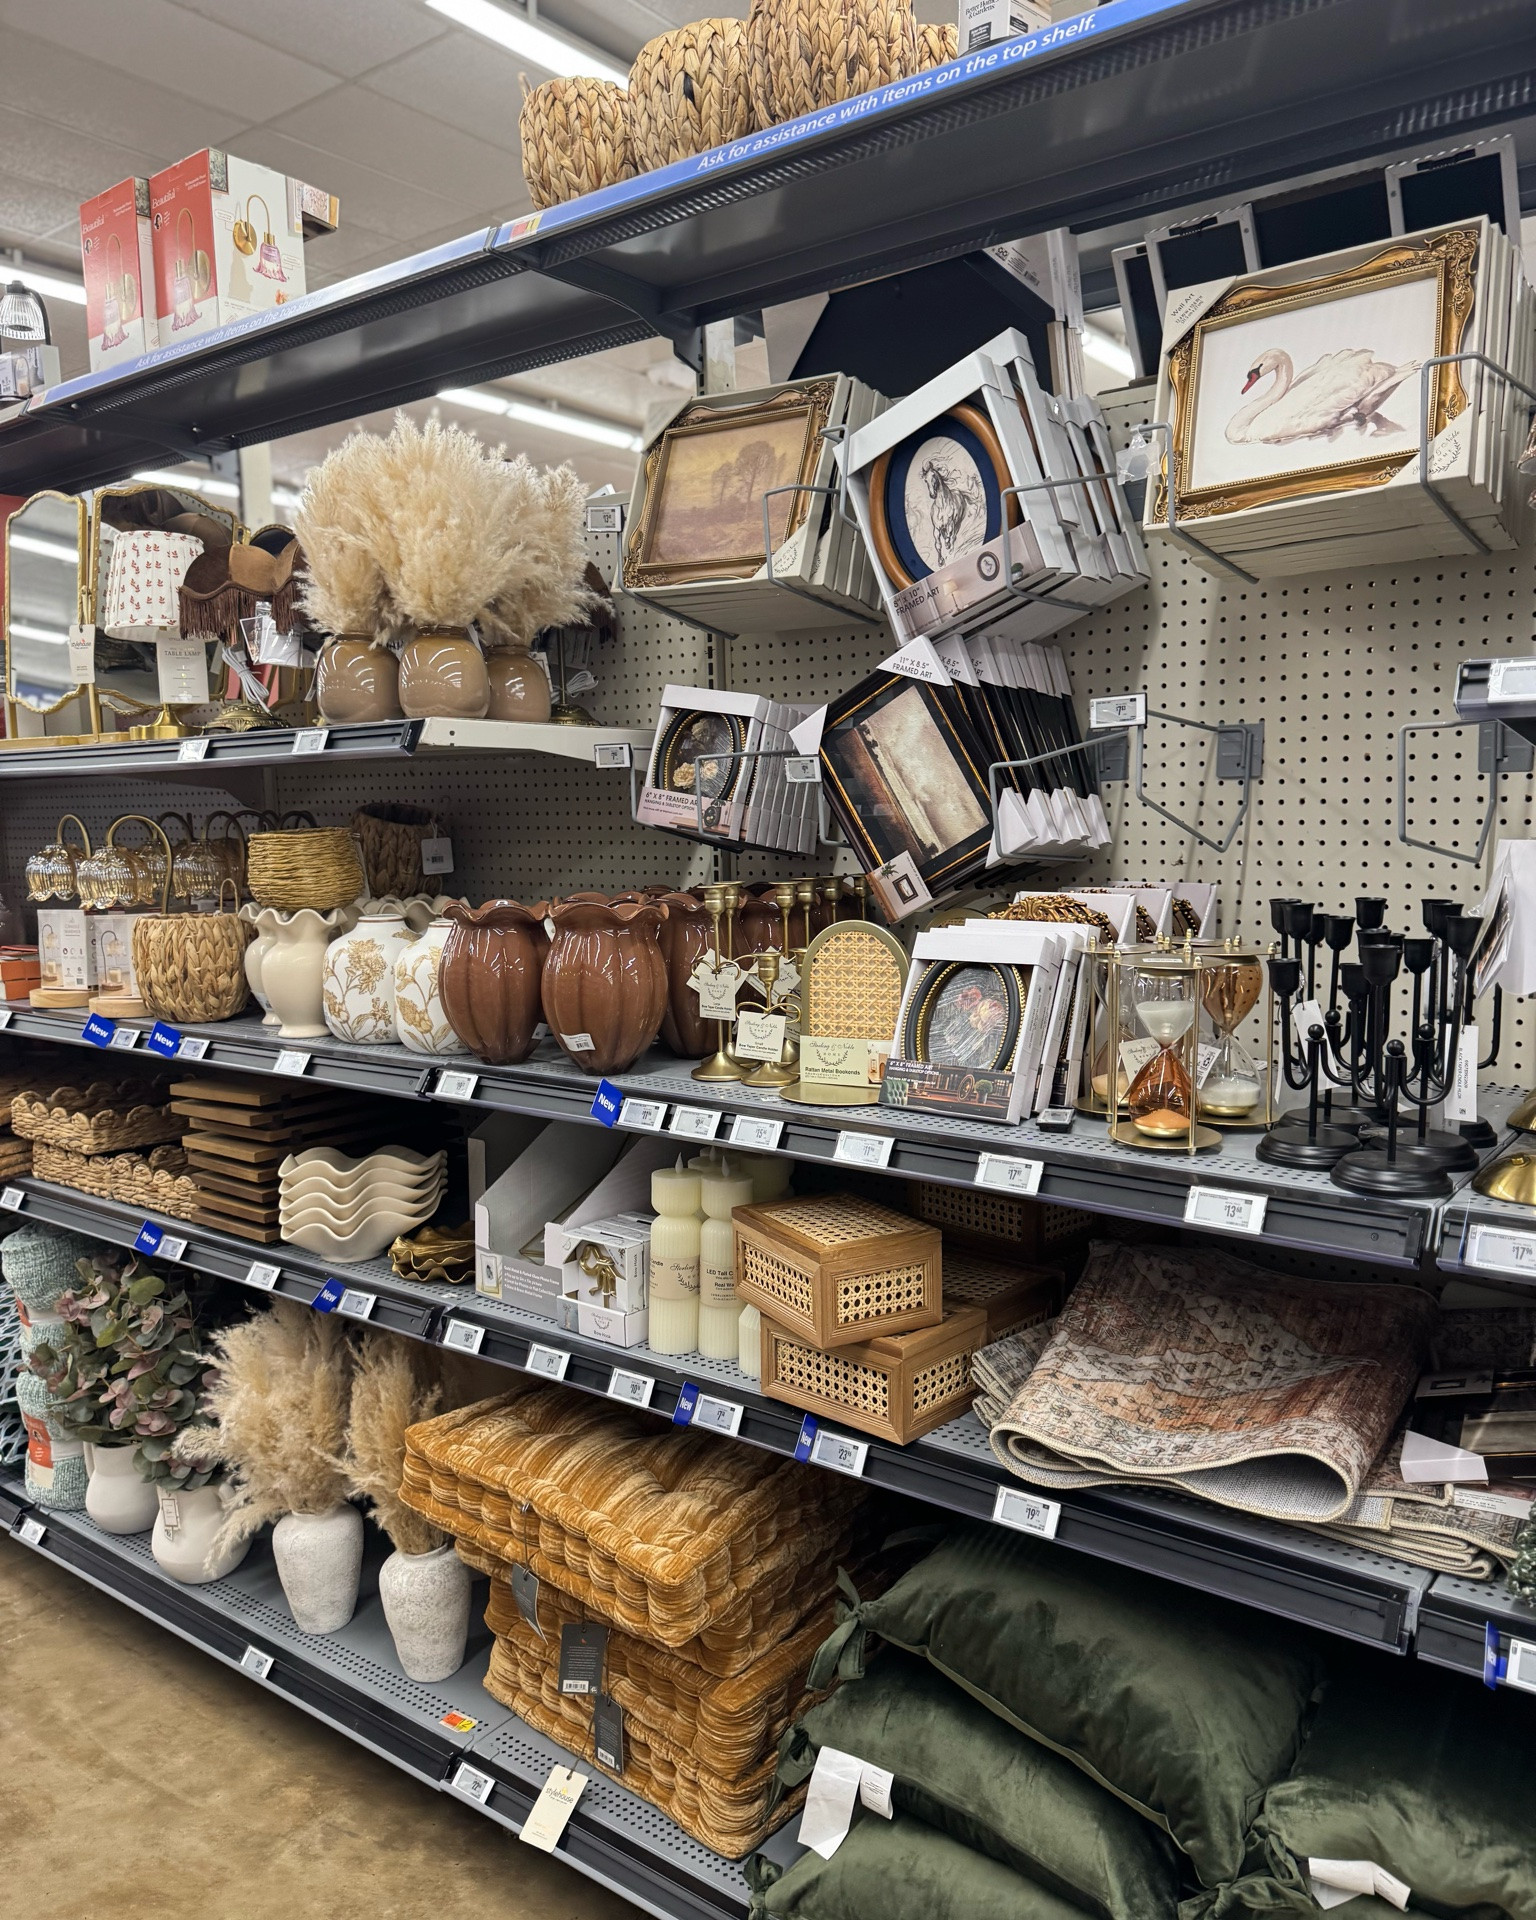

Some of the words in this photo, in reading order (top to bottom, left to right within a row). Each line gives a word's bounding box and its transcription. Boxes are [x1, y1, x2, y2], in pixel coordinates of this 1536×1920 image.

[973, 5, 995, 17] Gardens
[697, 152, 725, 171] Ask
[728, 143, 751, 160] for
[753, 112, 836, 150] assistance
[840, 94, 878, 120] with
[882, 77, 932, 104] items
[936, 66, 960, 83] on
[965, 55, 998, 74] the
[1002, 40, 1037, 61] top
[1041, 14, 1096, 45] shelf.
[152, 187, 176, 209] Beautiful
[82, 213, 105, 235] Beautiful
[1171, 299, 1185, 317] Wall
[1185, 292, 1196, 303] Art
[135, 357, 150, 368] Ask
[150, 353, 162, 365] for
[163, 339, 203, 359] assistance
[204, 331, 224, 344] with
[225, 322, 250, 337] items
[250, 317, 262, 328] on
[263, 312, 278, 325] the
[909, 586, 920, 597] 10"
[896, 595, 925, 617] FRAMED
[926, 586, 940, 600] ART
[899, 656, 909, 664] 11"
[916, 660, 930, 669] 8.5"
[946, 658, 959, 667] 8.5"
[892, 663, 919, 675] FRAMED
[920, 669, 933, 679] ART
[948, 668, 961, 677] ART
[644, 799, 662, 807] HANGING
[645, 791, 653, 799] 6"
[658, 792, 666, 801] 8"
[666, 794, 689, 805] FRAMED
[689, 798, 698, 807] AR
[89, 1022, 109, 1038] New
[154, 1032, 175, 1048] New
[598, 1092, 616, 1113] New
[141, 1231, 158, 1246] New
[320, 1289, 338, 1303] New
[679, 1397, 693, 1411] New
[800, 1430, 812, 1447] New
[545, 1786, 574, 1804] stylehouse
